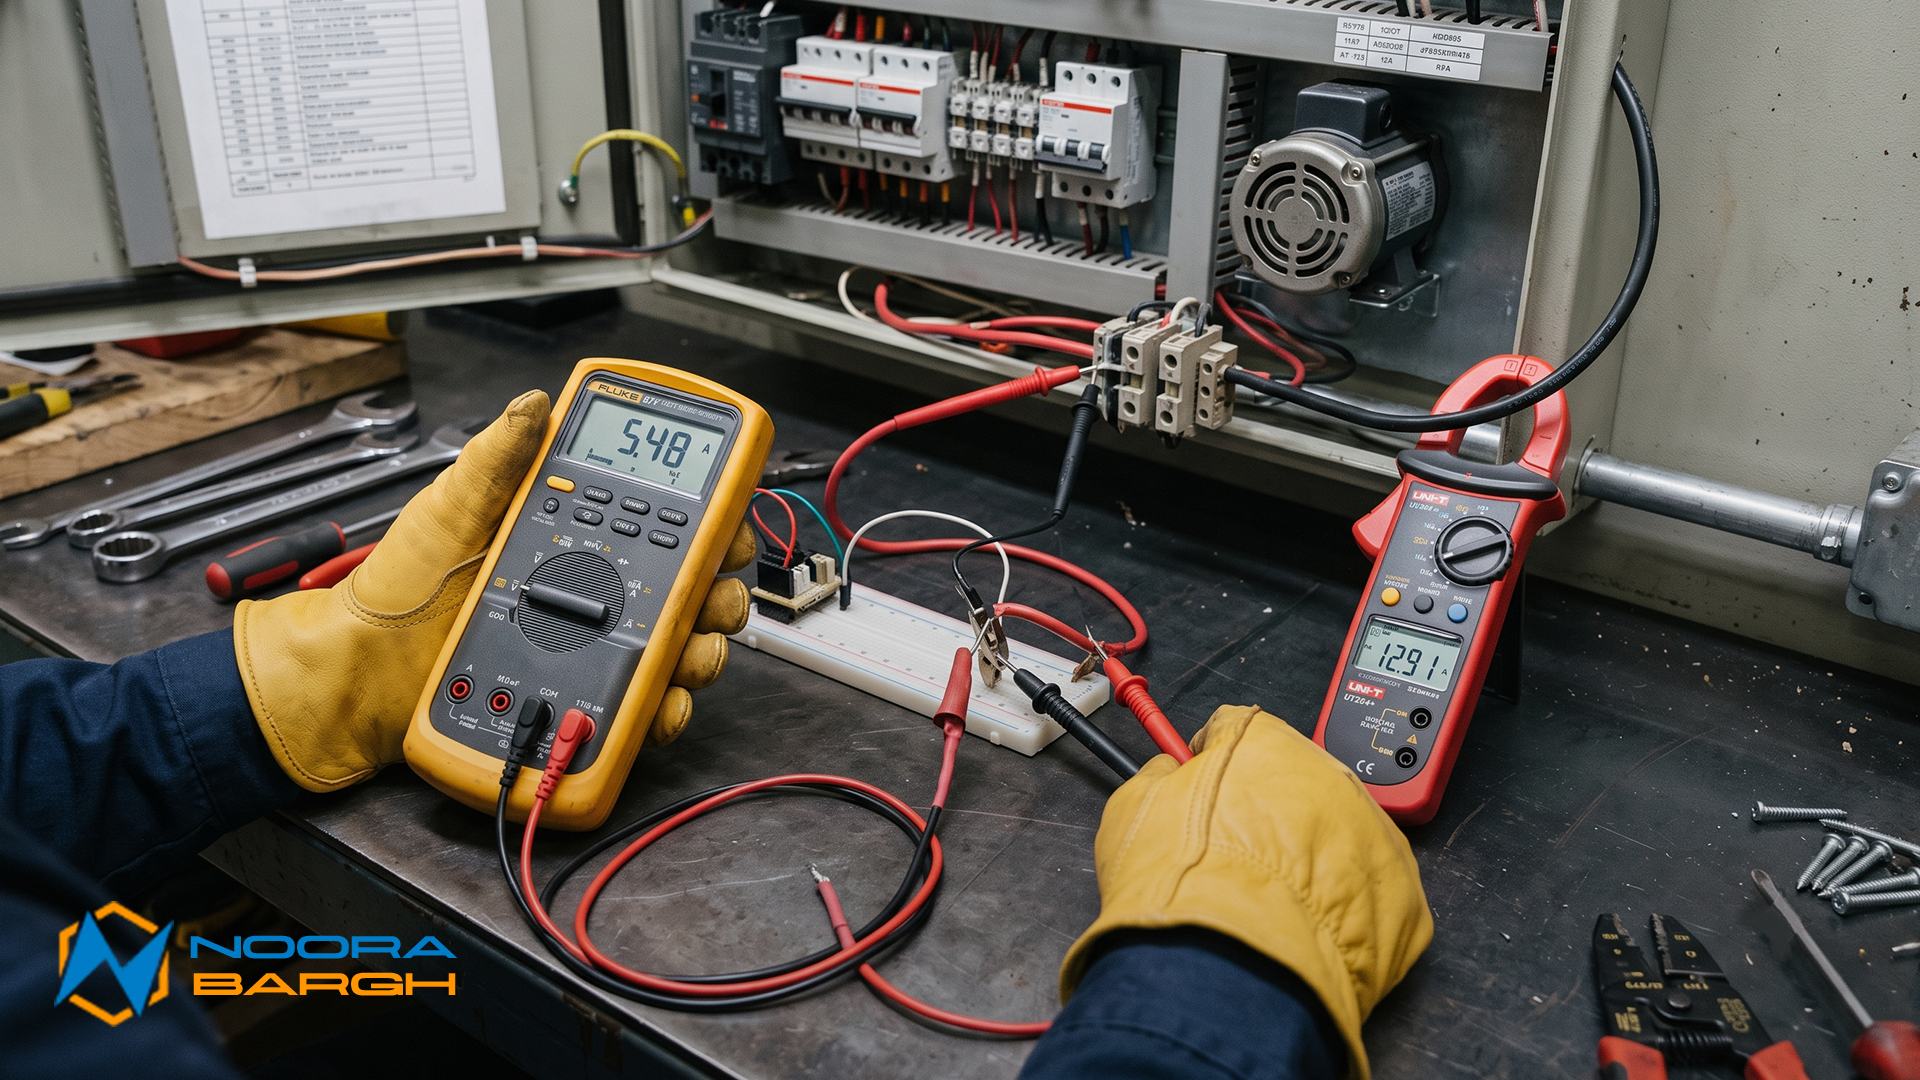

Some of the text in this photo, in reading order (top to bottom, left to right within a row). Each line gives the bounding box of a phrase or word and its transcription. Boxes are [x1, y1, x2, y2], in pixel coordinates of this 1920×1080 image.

[597, 383, 640, 401] FLUKE
[616, 417, 711, 470] 5.48 A
[1412, 490, 1449, 504] UNI-T
[465, 663, 473, 672] A
[1378, 642, 1440, 681] 12.91
[1348, 681, 1384, 697] UNI-T
[1355, 759, 1376, 776] CE
